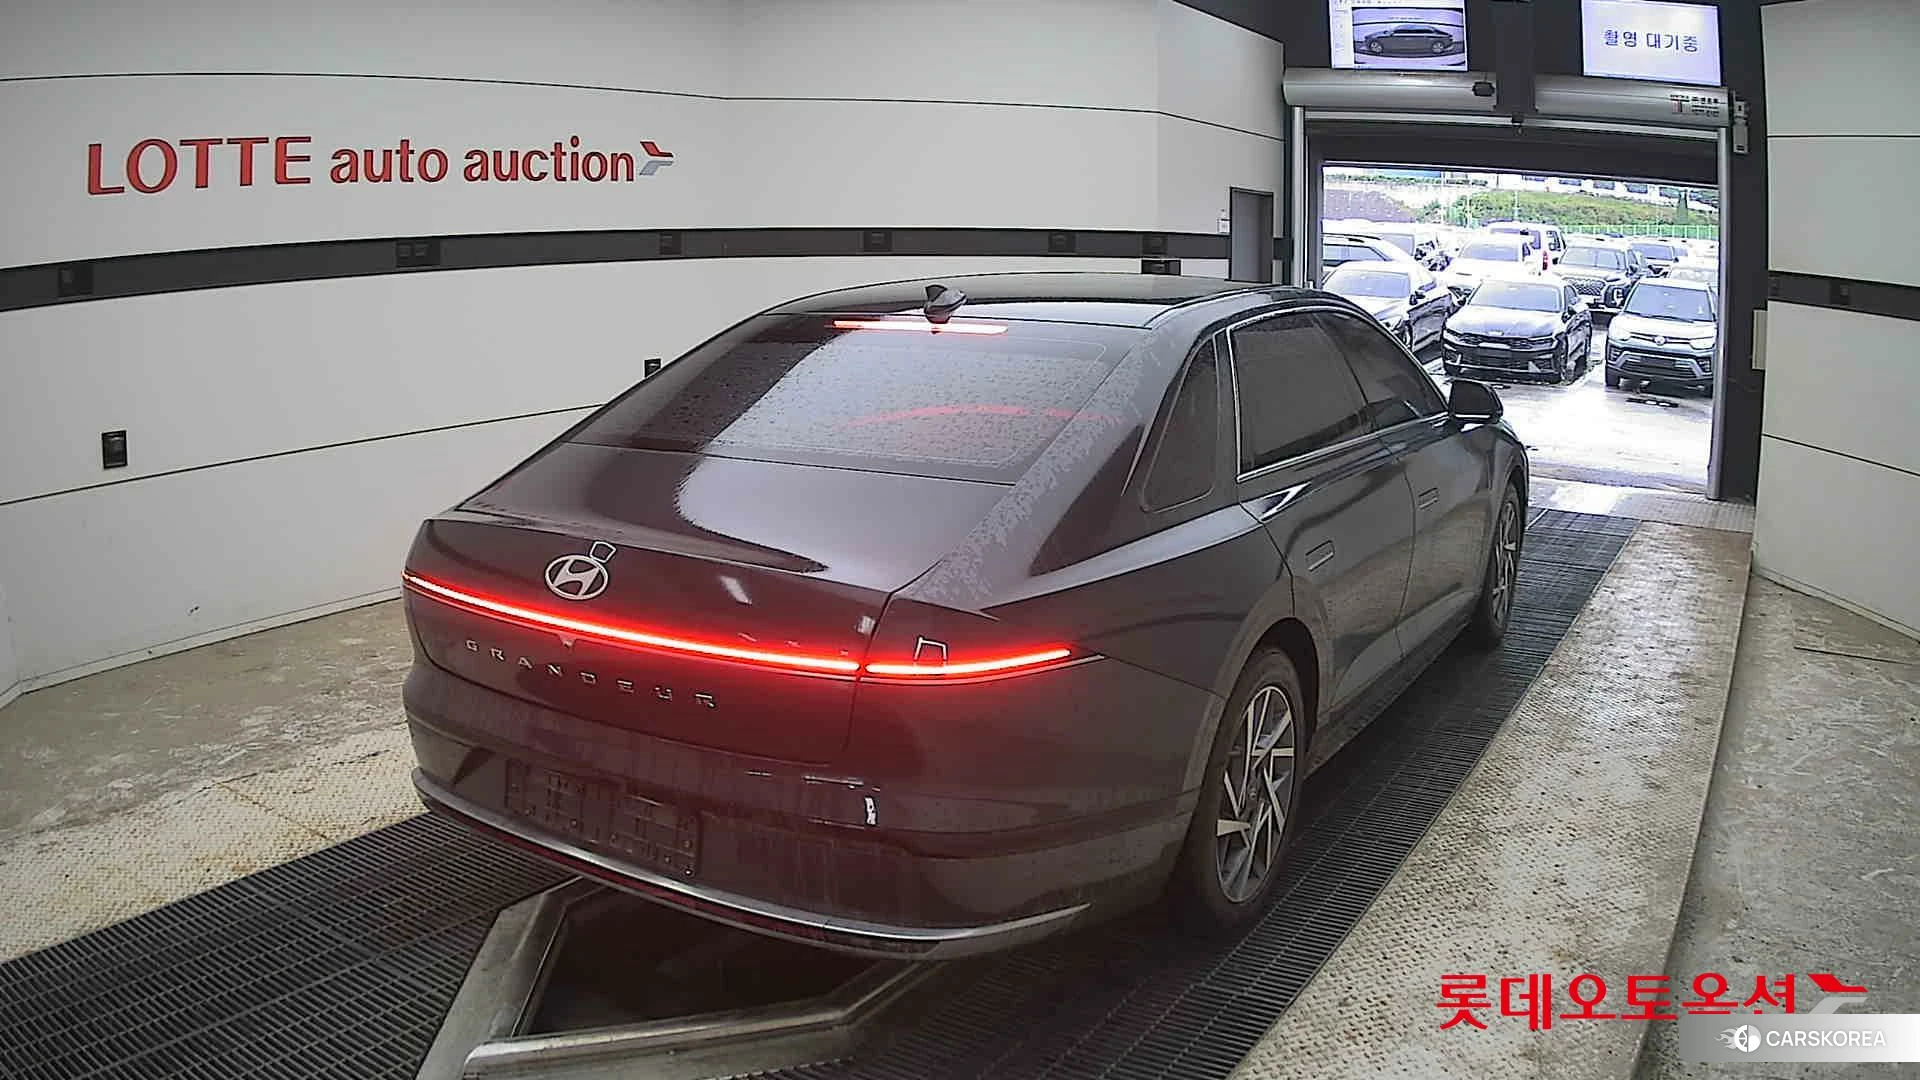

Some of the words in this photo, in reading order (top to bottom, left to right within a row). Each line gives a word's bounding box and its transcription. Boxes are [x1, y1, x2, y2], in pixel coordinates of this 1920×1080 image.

[1646, 32, 1698, 52] 대기중
[87, 136, 311, 195] LOTTE
[330, 139, 449, 182] auto
[463, 136, 635, 182] auction
[465, 638, 717, 709] GRANDEUR
